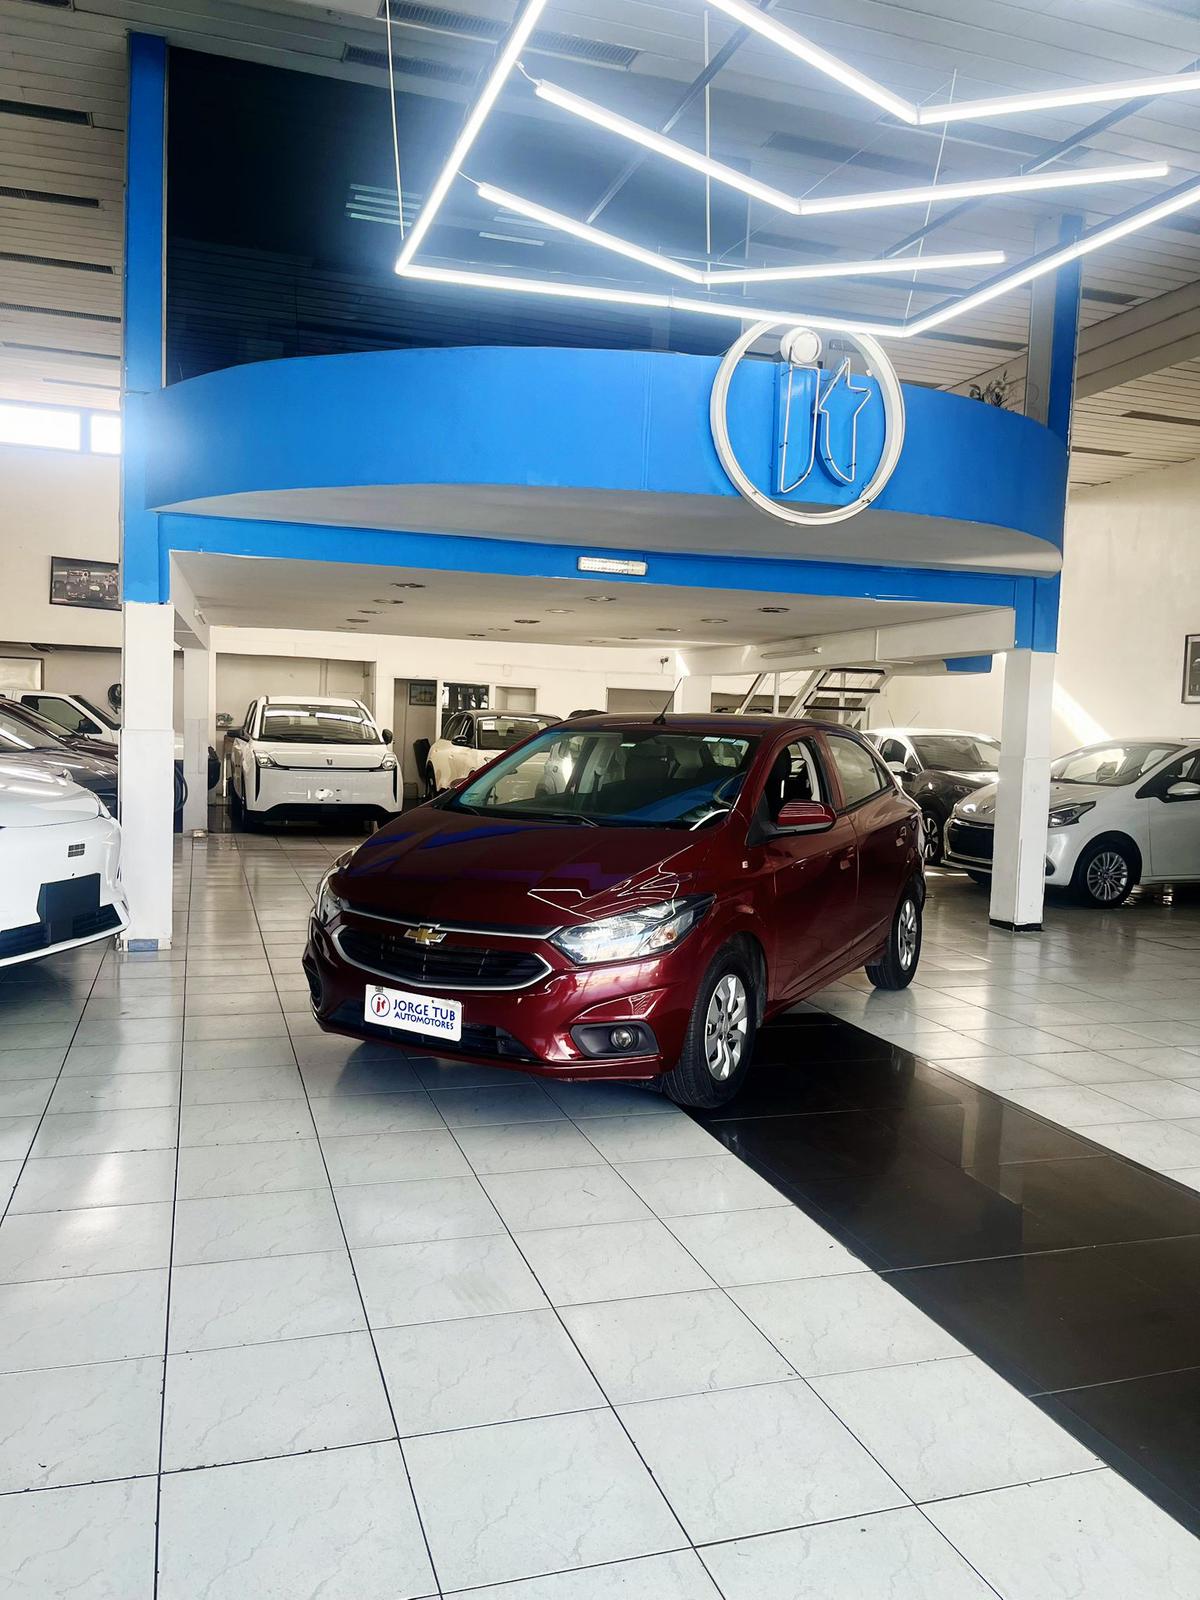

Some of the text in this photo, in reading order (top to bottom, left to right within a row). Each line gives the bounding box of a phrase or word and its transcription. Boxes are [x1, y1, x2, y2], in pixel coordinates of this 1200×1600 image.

[394, 999, 455, 1021] JORGE TUB
[394, 1012, 454, 1030] AUTOMOTORES
